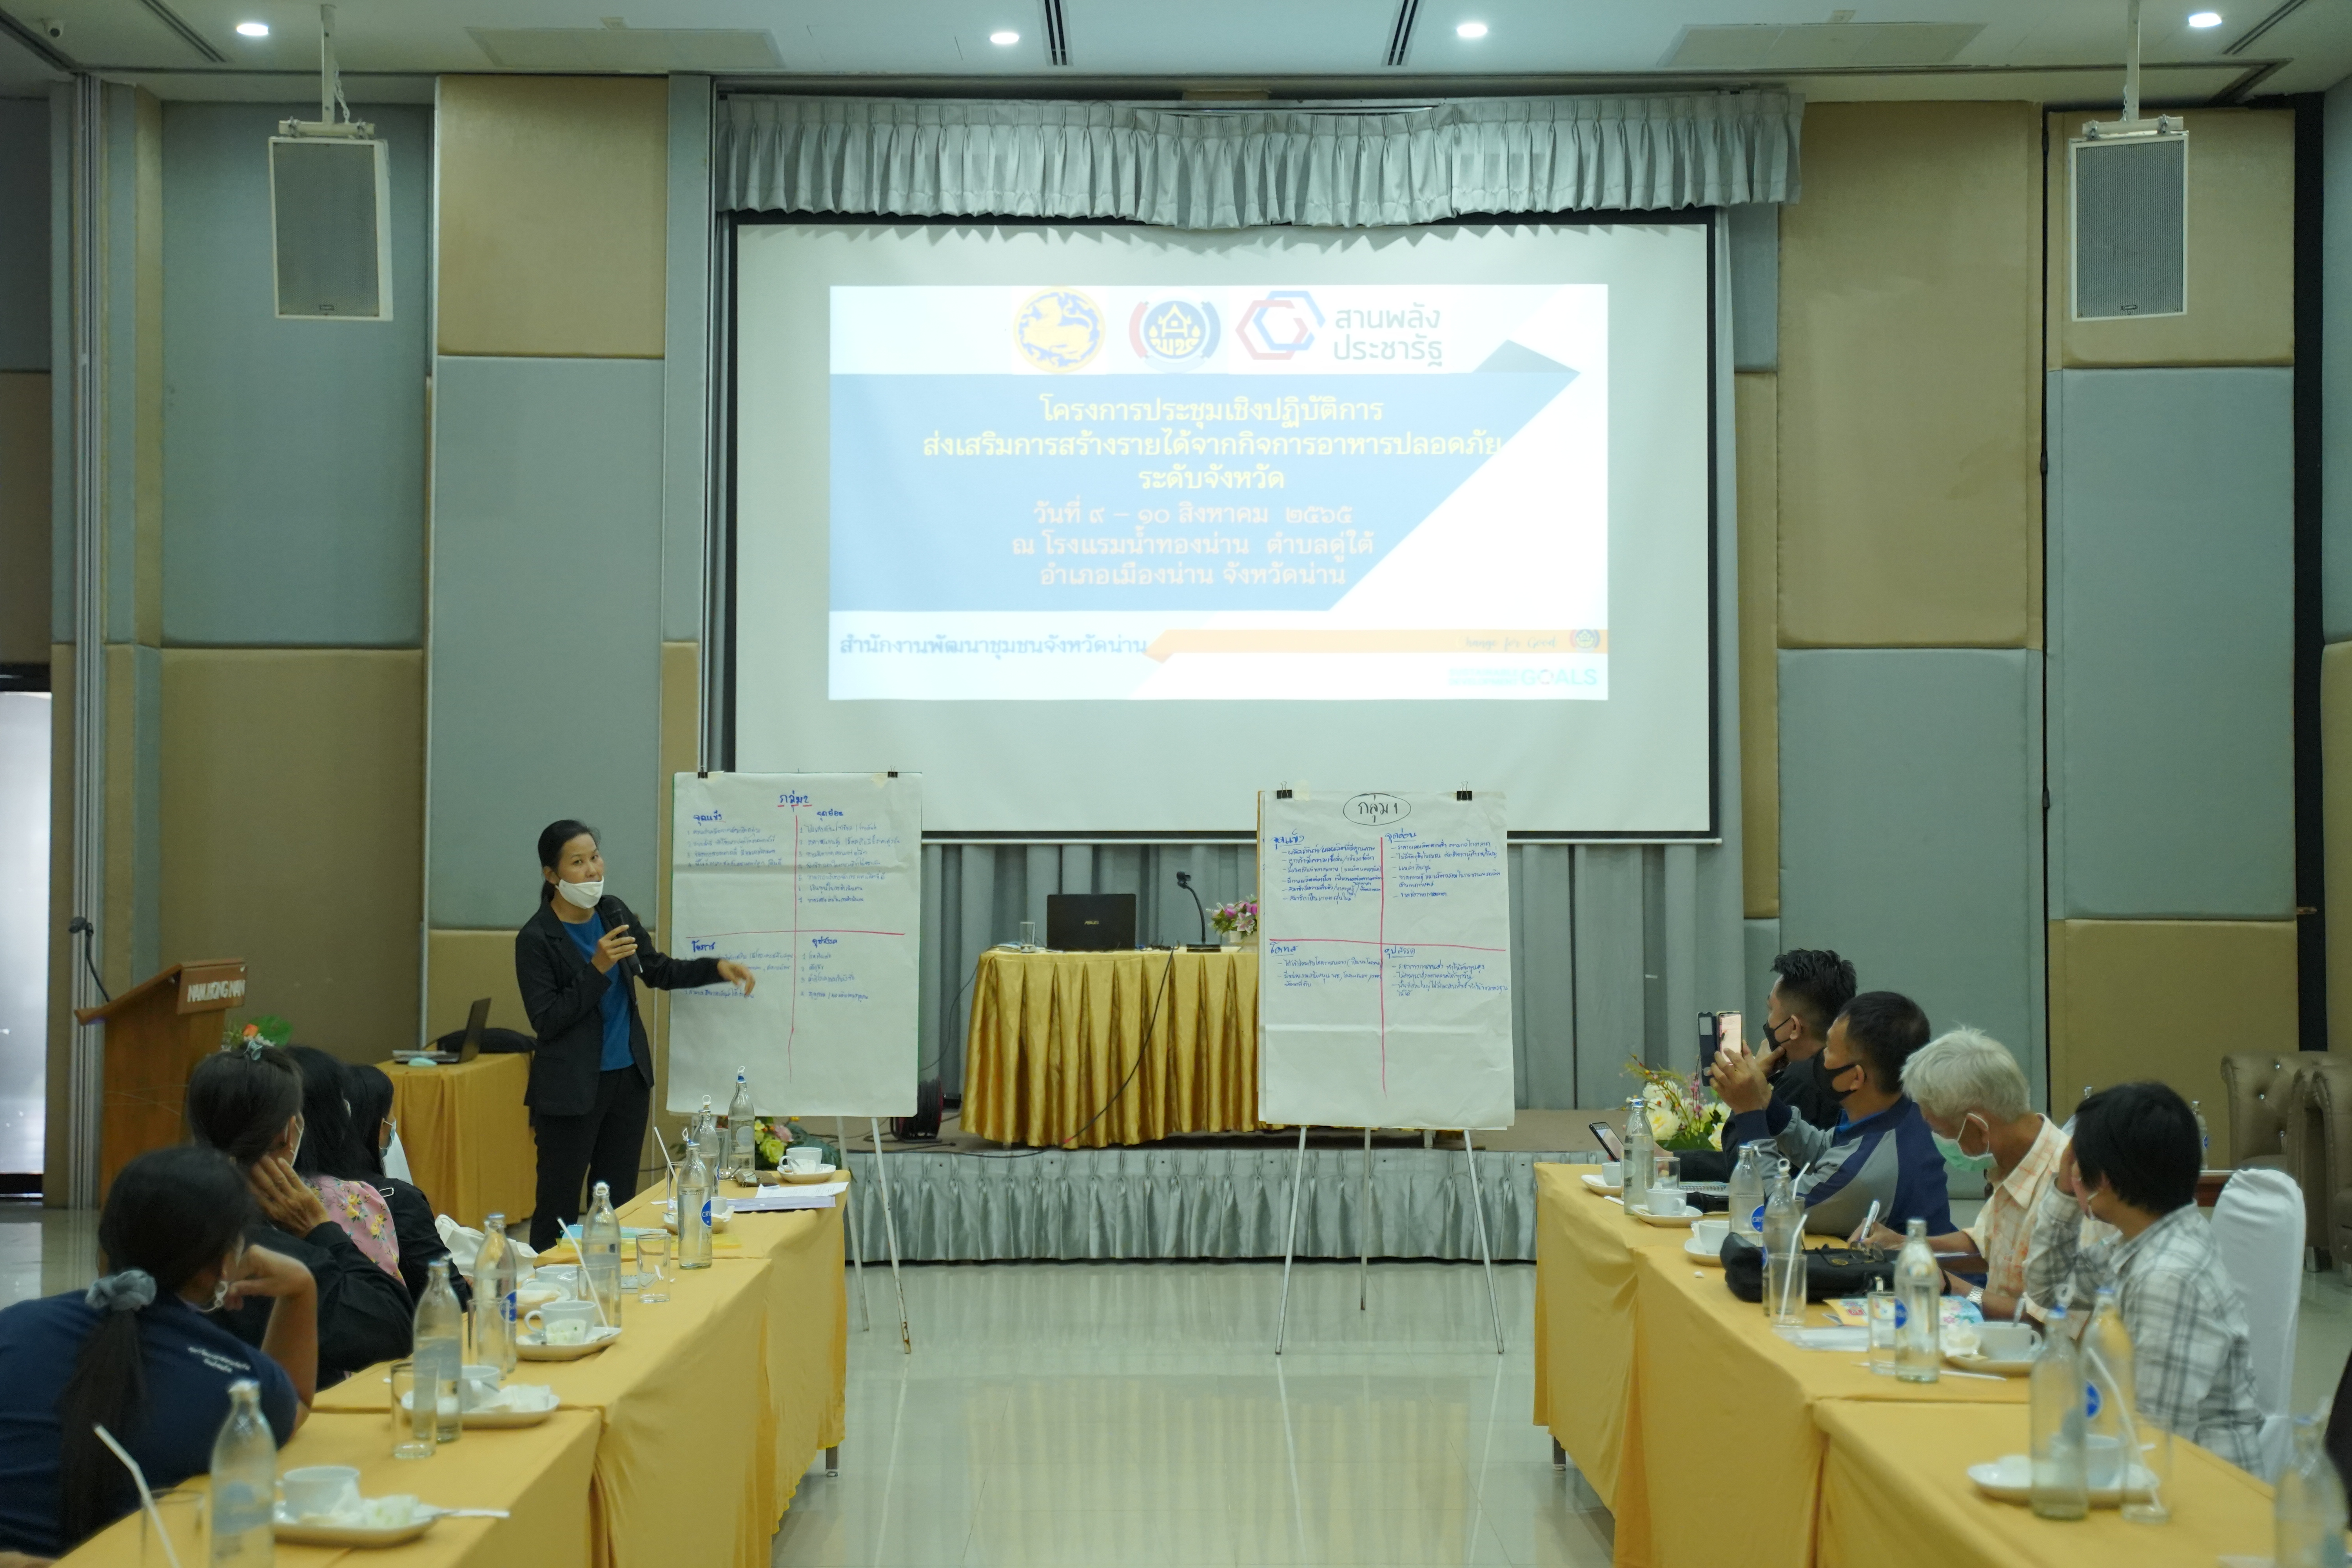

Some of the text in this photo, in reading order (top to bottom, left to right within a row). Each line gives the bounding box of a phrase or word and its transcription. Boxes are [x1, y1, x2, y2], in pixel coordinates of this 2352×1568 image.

[1336, 301, 1440, 330] สานพลัง
[1333, 334, 1443, 367] ประชารัฐ
[1039, 393, 1384, 428] โครงการประชุมเชิงปฏิบัติการ
[923, 427, 1504, 456] ส่งเสริมการสร้างรายได้จากกิจการอาหารปลอดภัย
[1139, 463, 1285, 489] ระดับจังหวัด
[1033, 495, 1081, 524] วันที่
[1138, 508, 1170, 524] ๑๐
[1178, 504, 1269, 524] สิงหาคม
[1285, 505, 1354, 524] ๒๕๖๕
[1012, 525, 1374, 562] ณ โรงแรมน้ำทองน่าน ตำบลดู่ใต้
[1040, 561, 1346, 585] อำเภอเมืองน่าน จังหวัดน่าน
[840, 633, 1147, 661] สำนักงานพัฒนาชุมชนจังหวัดน่าน
[1504, 637, 1521, 652] for
[1527, 636, 1557, 650] Good
[1522, 669, 1597, 686] GOALS
[1358, 794, 1388, 823] กลุ่ม
[1385, 828, 1417, 844] จุดอ่อน
[1384, 945, 1416, 959] อุปสรรค
